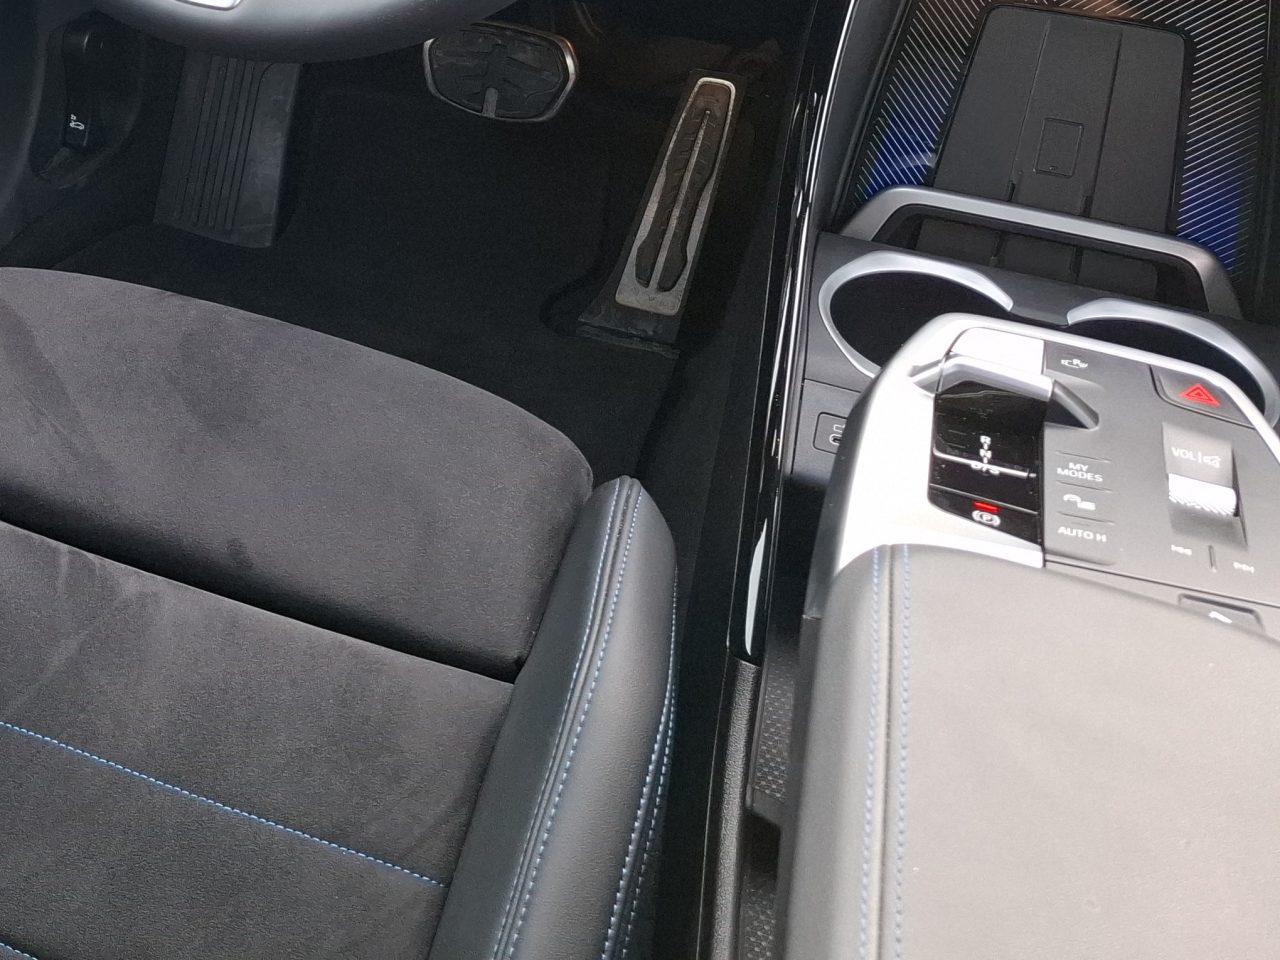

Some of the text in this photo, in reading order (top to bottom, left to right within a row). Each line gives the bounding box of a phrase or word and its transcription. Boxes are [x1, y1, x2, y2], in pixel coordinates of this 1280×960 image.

[1171, 446, 1197, 462] VOL
[1068, 461, 1089, 471] MY
[1056, 467, 1104, 482] MODES
[1057, 526, 1108, 543] AUTO H
